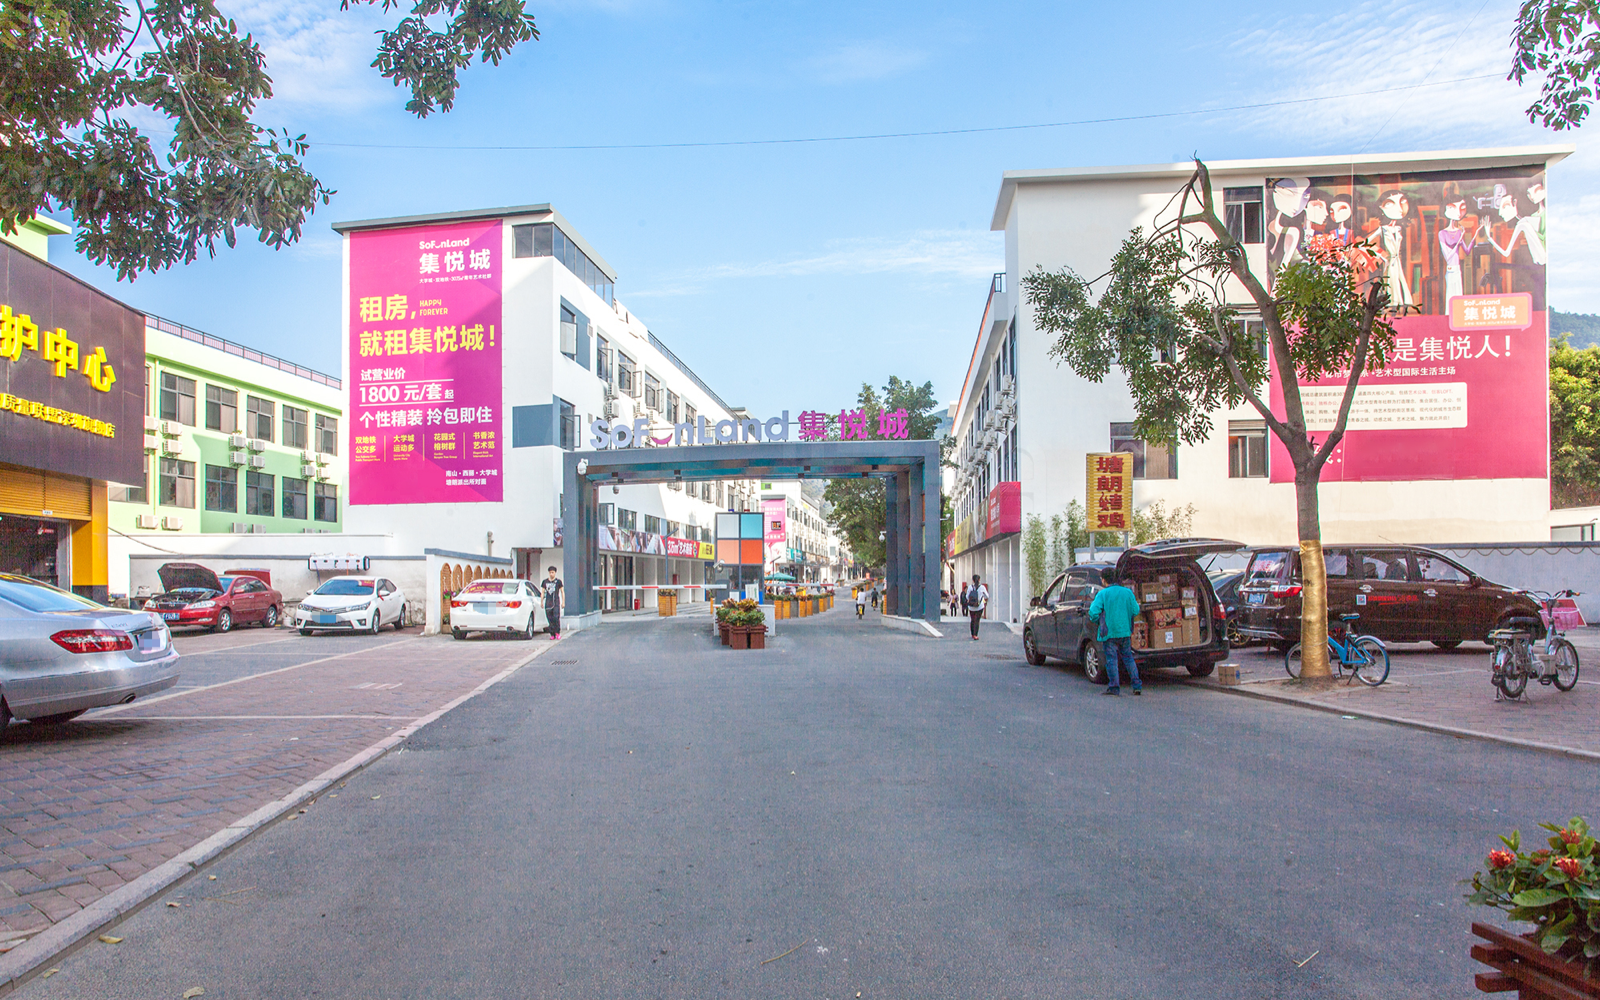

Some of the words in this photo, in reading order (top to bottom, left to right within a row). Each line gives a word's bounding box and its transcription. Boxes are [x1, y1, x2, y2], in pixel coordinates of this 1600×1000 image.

[419, 248, 491, 274] 集悦城
[419, 299, 442, 307] HAPPY
[419, 307, 449, 317] FOREVER
[1463, 305, 1517, 321] 集悦城
[359, 323, 496, 358] 就租集悦城！
[0, 304, 117, 392] 护中心
[360, 367, 406, 382] 试营业价
[359, 385, 400, 403] 1800
[359, 410, 423, 428] 个性精装
[426, 406, 493, 426] 拎包即住
[797, 407, 910, 441] 集悦城
[355, 435, 377, 444] 双地铁
[393, 433, 415, 442] 大学城
[433, 432, 456, 441] 花园式
[472, 431, 496, 440] 书香浓
[355, 445, 377, 454] 公交多
[393, 443, 415, 452] 运动多
[472, 440, 496, 450] 艺术范
[1096, 455, 1126, 529] 塘朗烤鸡
